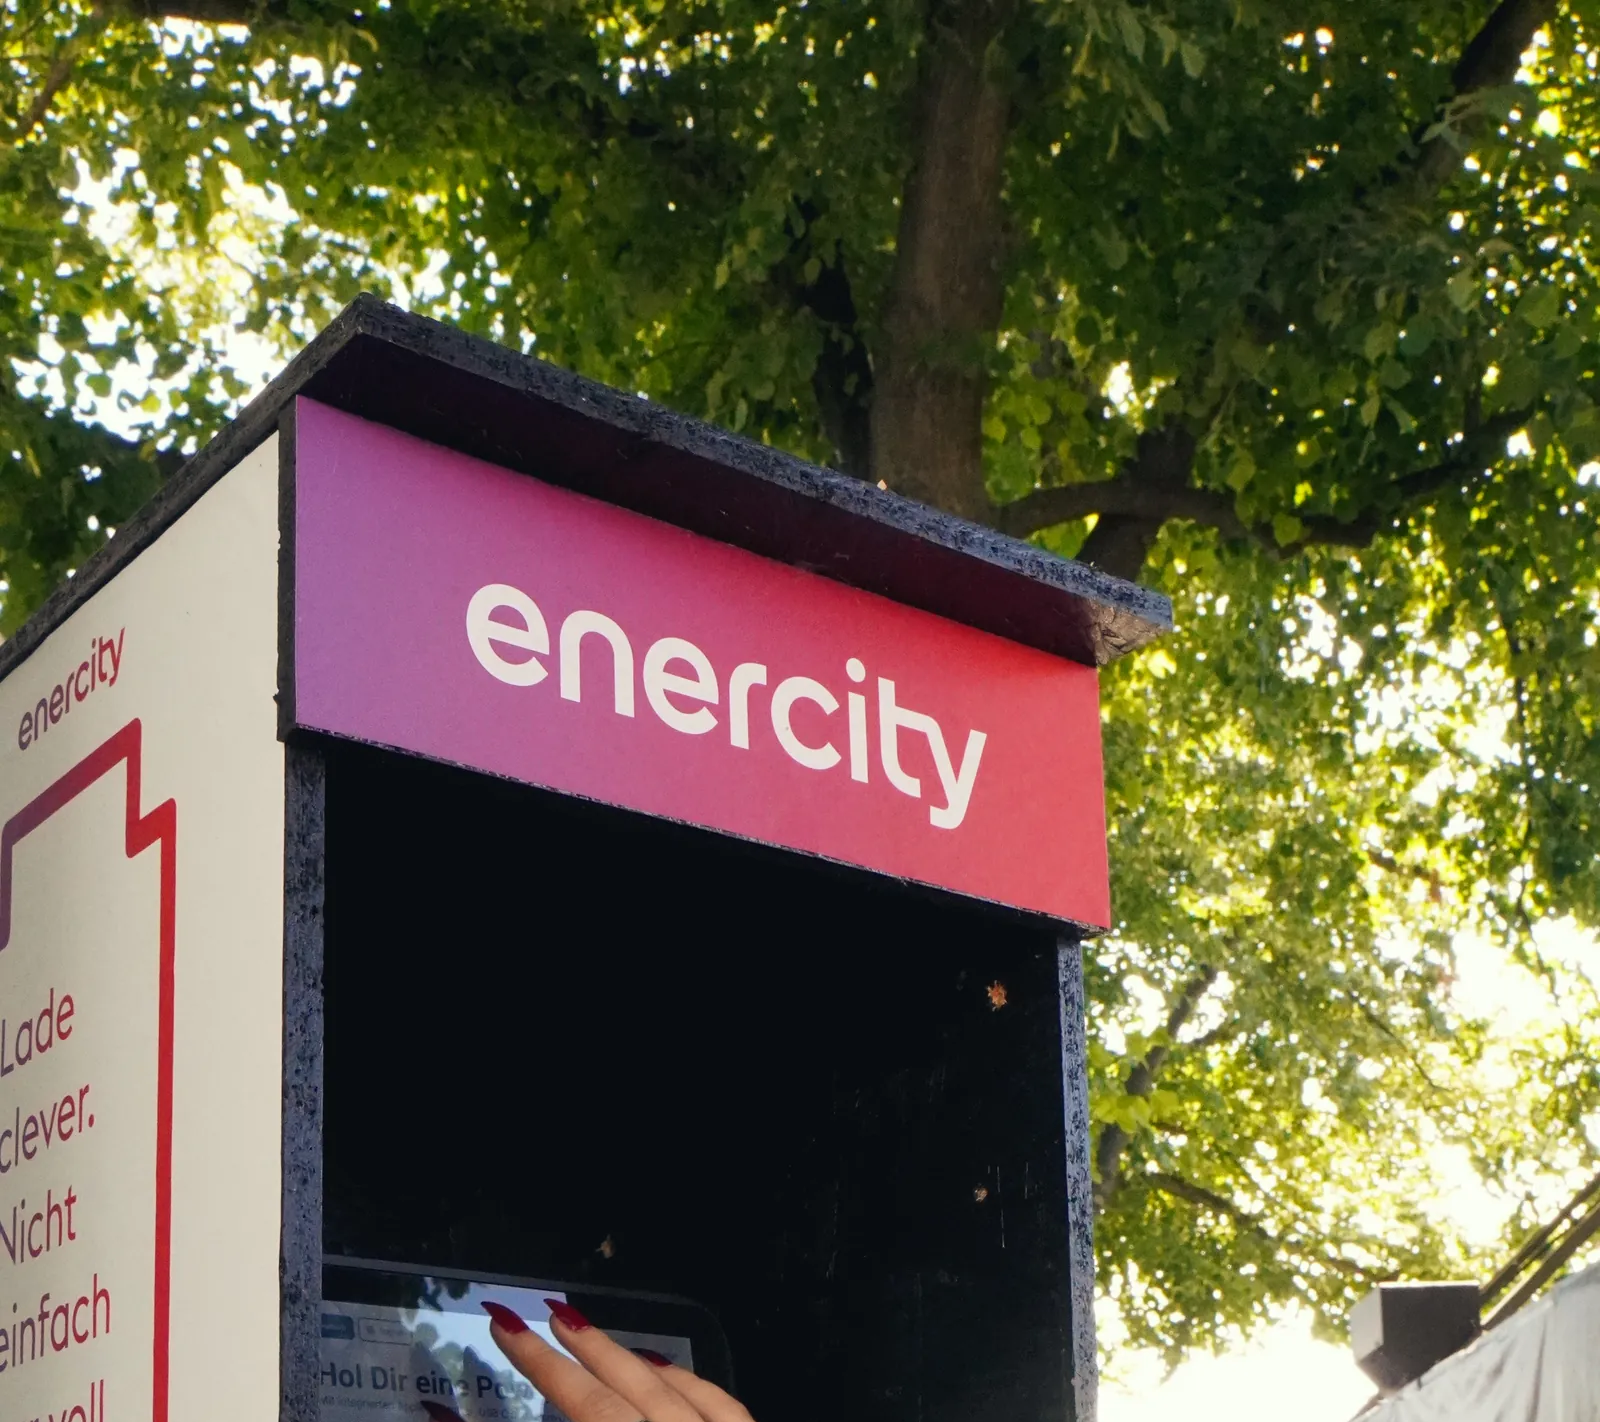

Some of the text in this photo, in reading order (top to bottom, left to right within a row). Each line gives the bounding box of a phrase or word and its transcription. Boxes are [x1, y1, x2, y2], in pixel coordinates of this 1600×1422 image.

[18, 627, 126, 751] enercity
[466, 583, 988, 830] enercity
[0, 987, 75, 1078] Lade
[0, 1084, 95, 1174] clever.
[320, 1361, 362, 1389] Hol
[370, 1366, 408, 1392] Dir
[415, 1371, 470, 1396] eine
